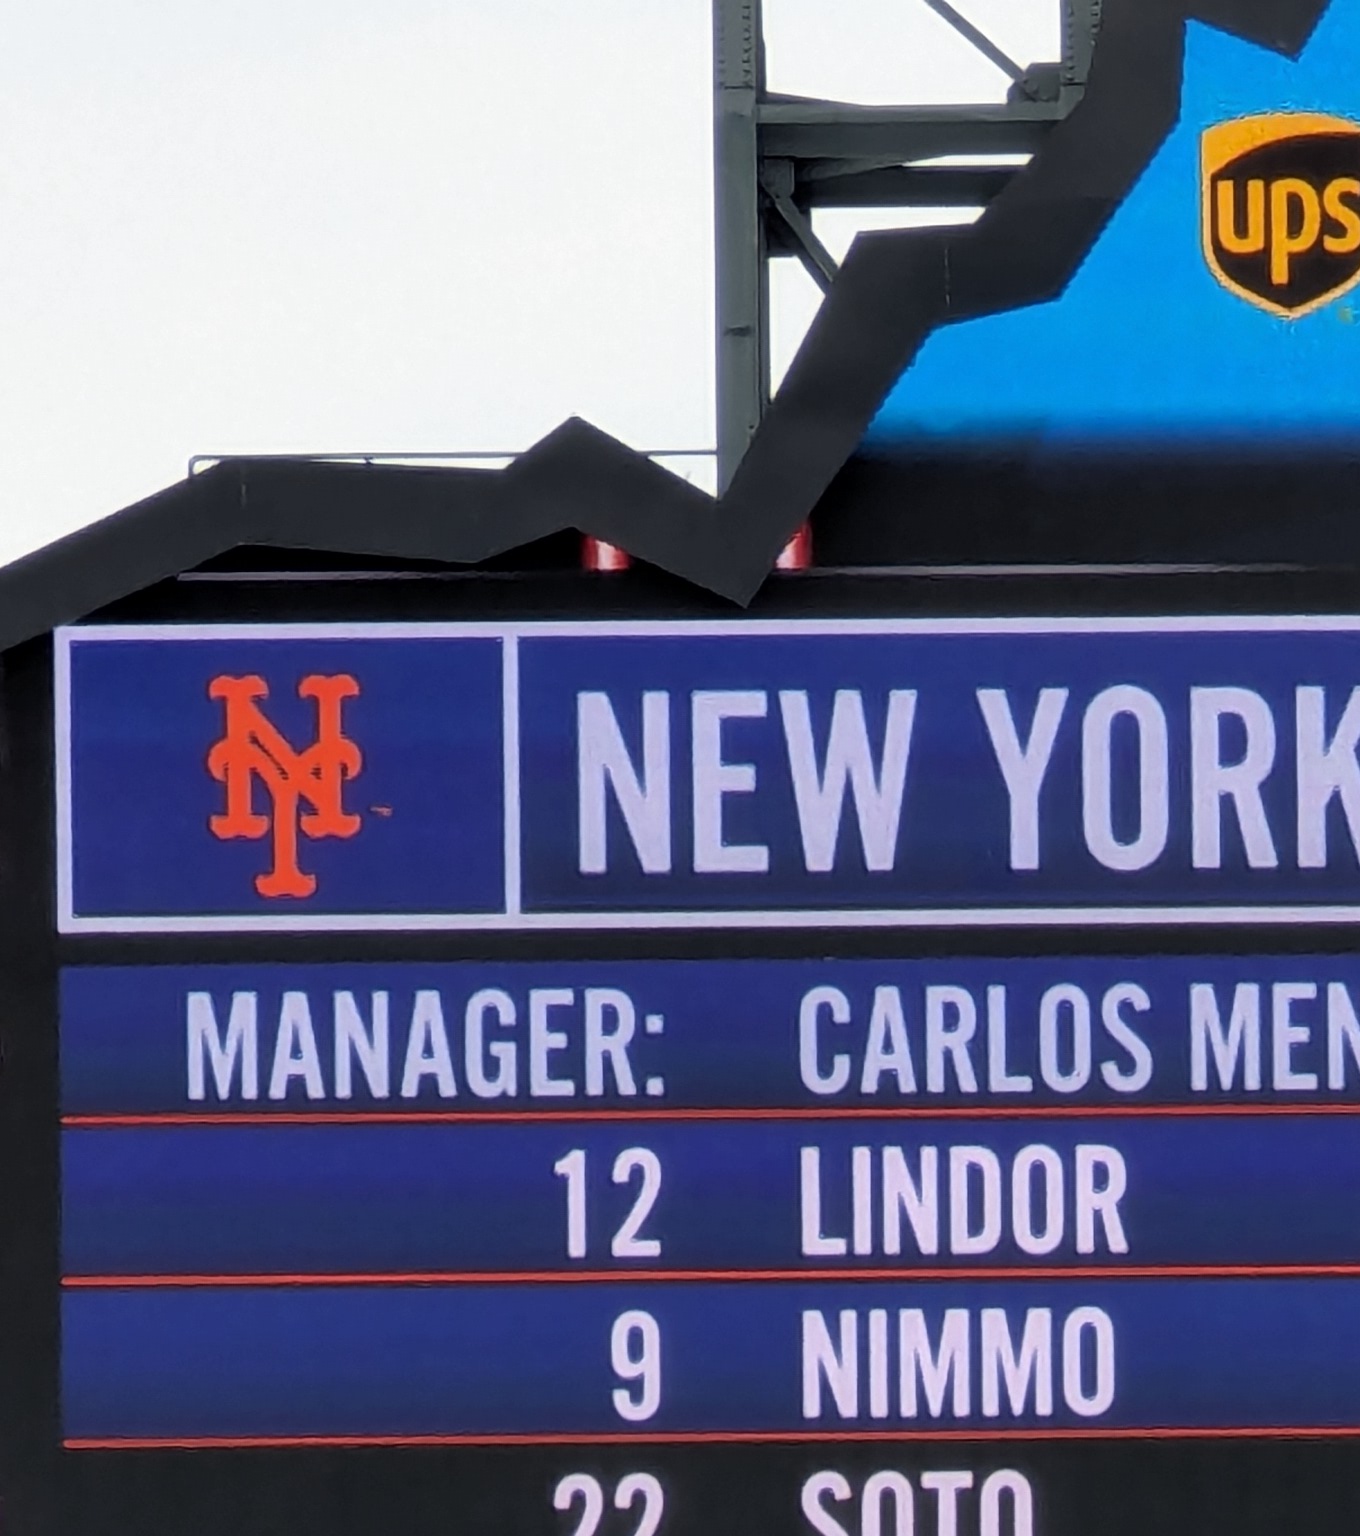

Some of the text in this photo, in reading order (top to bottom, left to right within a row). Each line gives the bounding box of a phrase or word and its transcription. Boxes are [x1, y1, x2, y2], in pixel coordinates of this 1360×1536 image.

[577, 689, 917, 873] NEW
[187, 988, 664, 1100] MANAGER:
[799, 983, 1153, 1095] CARLOS
[554, 1147, 662, 1258] 12
[800, 1144, 1129, 1256] LINDOR
[610, 1310, 661, 1421] 9
[802, 1306, 1115, 1419] NIMMO
